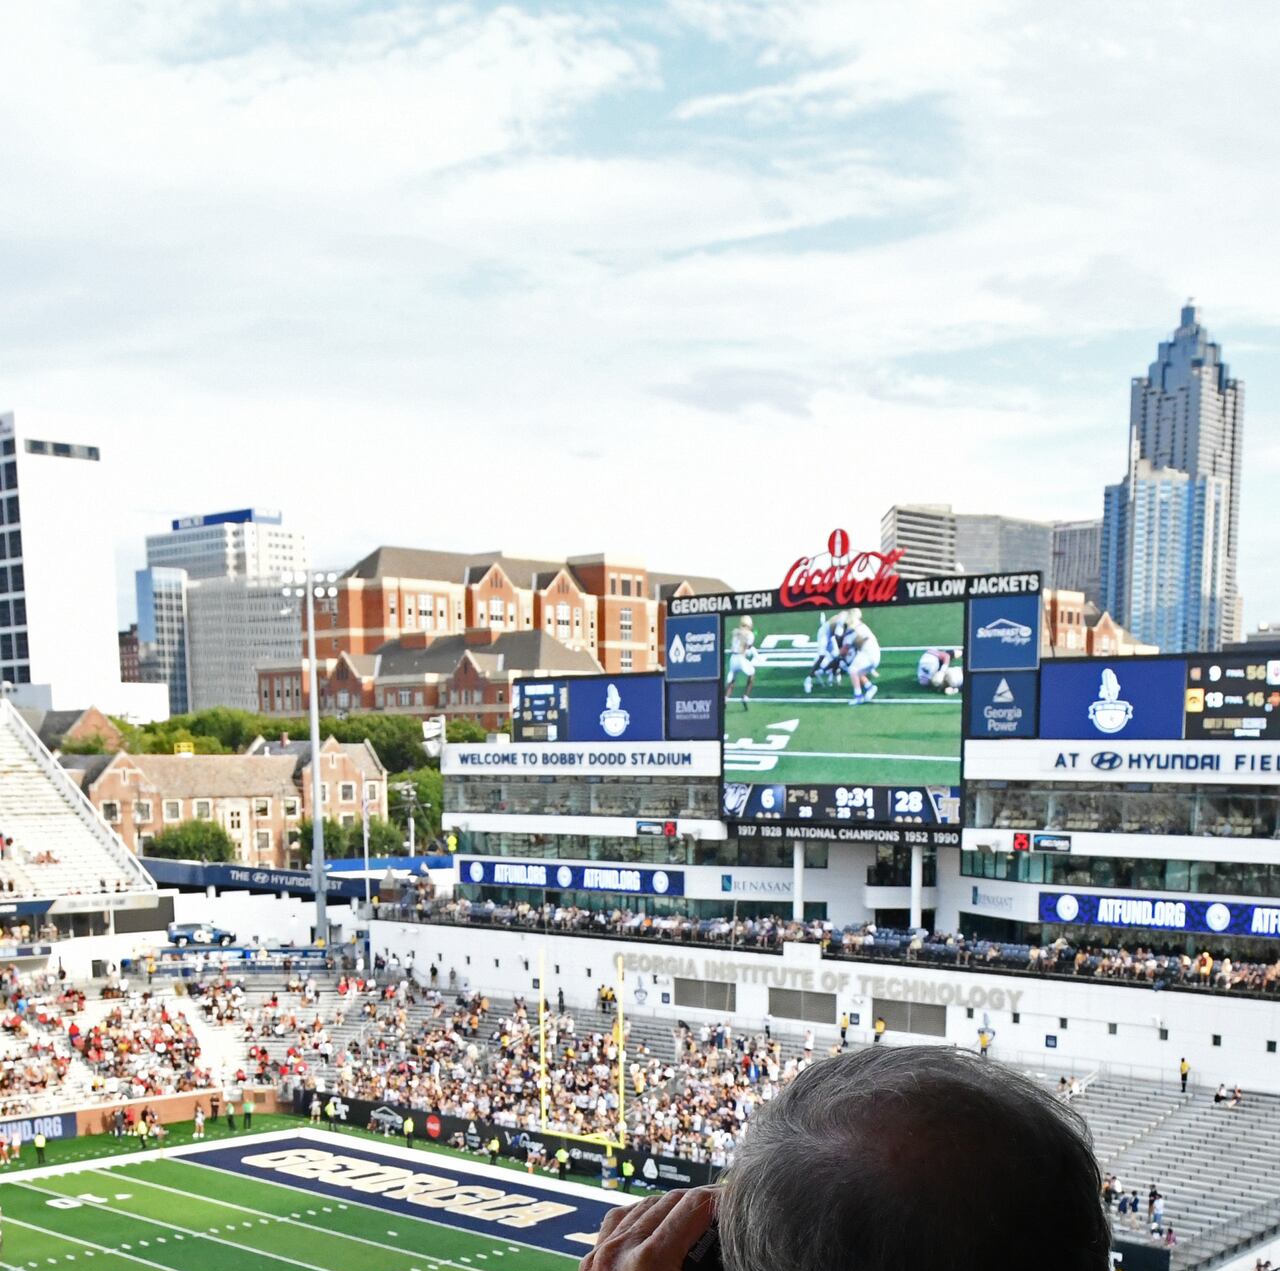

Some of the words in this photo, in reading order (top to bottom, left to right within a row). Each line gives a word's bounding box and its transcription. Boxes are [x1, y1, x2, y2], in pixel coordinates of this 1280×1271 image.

[906, 579, 966, 597] YELLOW
[969, 575, 1039, 594] JACKETS
[672, 595, 732, 614] GEORGIA
[734, 591, 772, 609] TECH
[675, 700, 712, 713] EMORY
[983, 705, 1022, 720] Georgia
[987, 719, 1018, 732] Power
[459, 752, 517, 766] WELCOME
[522, 752, 537, 766] TO
[542, 752, 584, 766] BOBBY
[588, 752, 626, 766] DODD
[631, 752, 692, 766] STADIUM
[1054, 752, 1080, 768] AT
[1128, 753, 1220, 770] HYUNDAI
[761, 788, 775, 809] 6
[894, 790, 923, 812] 28
[738, 826, 756, 837] 1917
[761, 826, 782, 838] 1928
[786, 827, 837, 841] NATIONAL
[839, 829, 900, 842] CHAMPIONS
[905, 831, 928, 843] 1952
[933, 832, 959, 845] 1990
[230, 870, 249, 882] THE
[271, 875, 312, 888] HYUNDA
[494, 864, 547, 886] ATFUND.ORG
[583, 868, 640, 891] ATFUND.ORG
[1097, 898, 1186, 928] ATFUND.ORG
[613, 952, 699, 978] GEORGIA
[704, 959, 814, 988] INSTITUTE
[822, 968, 851, 993] OF
[856, 974, 1024, 1013] TECHNOLOGY
[241, 1148, 578, 1228] GEORGIA
